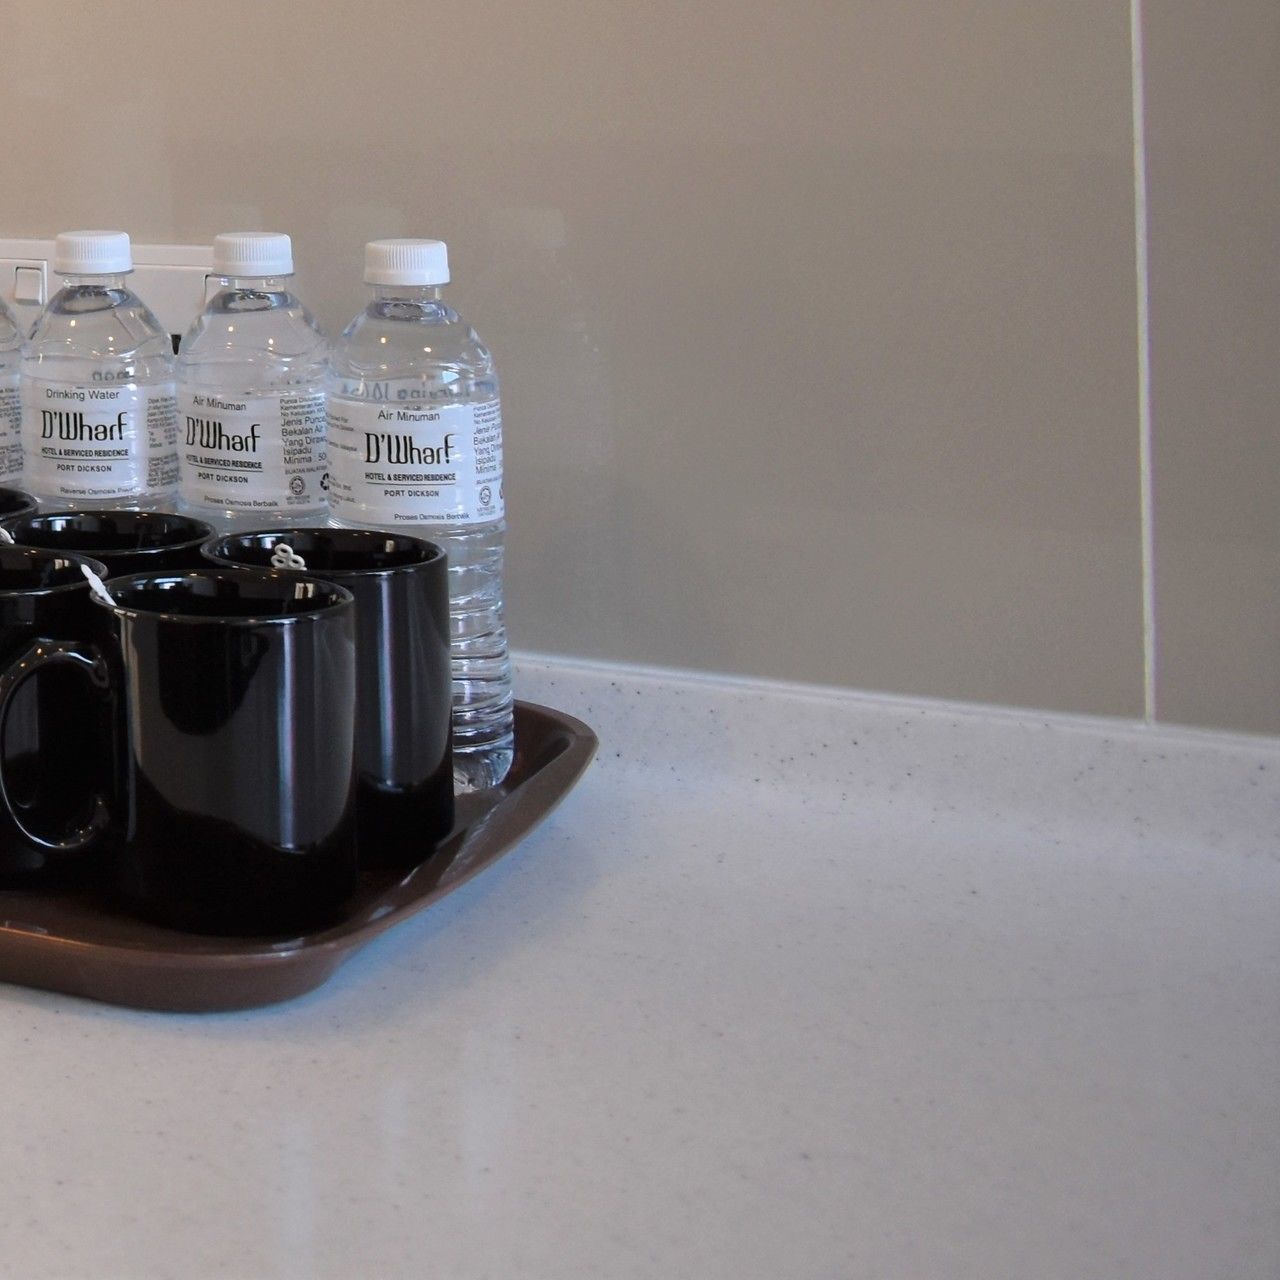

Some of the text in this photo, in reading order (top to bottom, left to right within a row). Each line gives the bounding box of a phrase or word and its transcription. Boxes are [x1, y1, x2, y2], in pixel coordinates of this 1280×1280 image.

[46, 388, 120, 402] Drinking Water
[193, 396, 247, 411] Air Minuman
[378, 410, 440, 422] Air Minuman
[40, 410, 128, 441] D'Wharf
[281, 418, 302, 427] Jenis
[186, 415, 261, 453] D'Wharf
[282, 425, 323, 437] Bekalan Air
[283, 439, 304, 448] Yang
[365, 432, 456, 465] D'Wharf
[41, 447, 57, 456] HOTEL
[63, 449, 94, 457] SERVICED
[94, 449, 129, 457] RESIDENCE
[283, 447, 312, 457] Isipadu
[204, 457, 230, 467] SERVICED
[231, 460, 262, 469] RESIDENCE
[284, 456, 312, 465] Minima
[198, 472, 248, 484] PORT DICKSON
[365, 472, 385, 481] HOTEL
[393, 473, 424, 481] SERVICED
[424, 473, 456, 481] RESIDENCE
